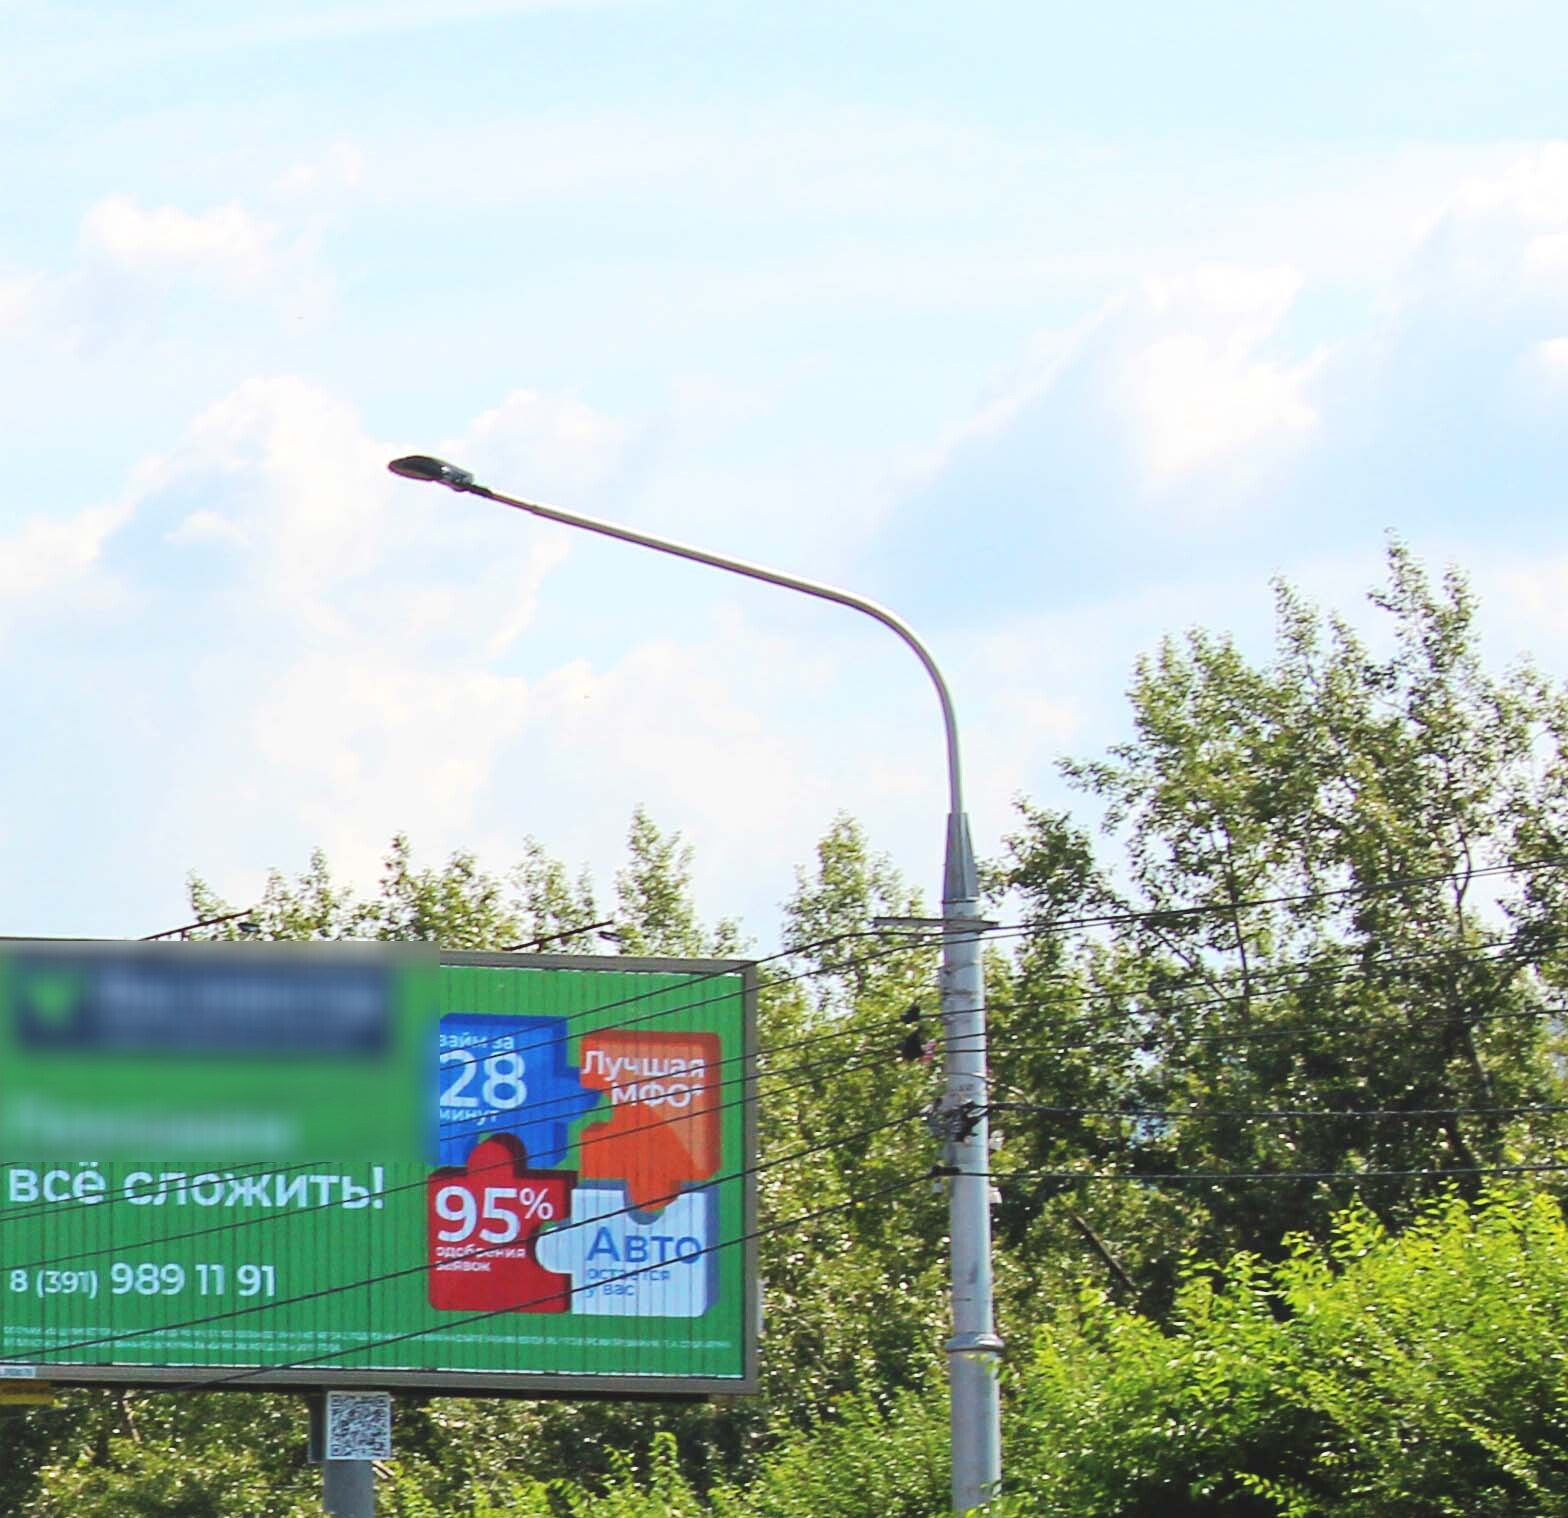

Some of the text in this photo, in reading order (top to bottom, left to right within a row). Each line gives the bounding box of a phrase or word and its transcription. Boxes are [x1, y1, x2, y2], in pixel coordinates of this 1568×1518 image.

[439, 1050, 527, 1109] 28
[582, 1051, 705, 1081] Лучшая
[8, 1162, 385, 1210] всё сложить!
[435, 1186, 553, 1244] 95%
[586, 1226, 702, 1264] Авто
[10, 1263, 275, 1299] 8 (391) 989 11 91
[604, 1284, 634, 1297] вас
